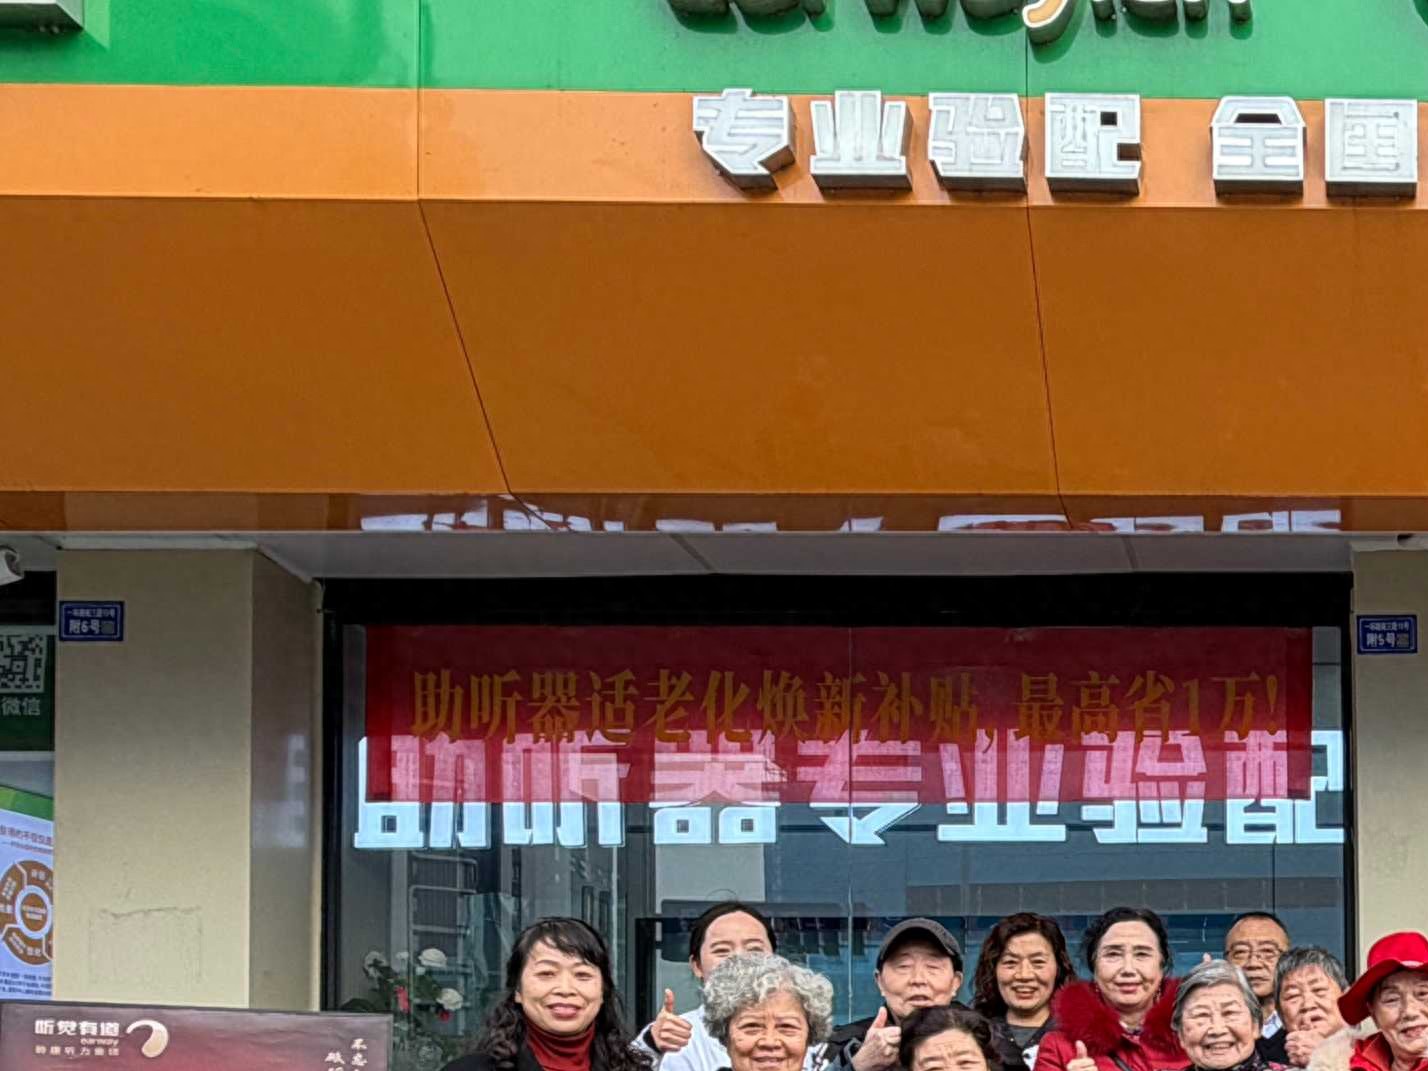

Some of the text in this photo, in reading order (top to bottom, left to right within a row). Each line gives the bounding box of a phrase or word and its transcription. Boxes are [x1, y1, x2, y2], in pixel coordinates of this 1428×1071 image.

[692, 88, 1140, 184] 专业验配
[34, 1019, 120, 1037] 听觉有道
